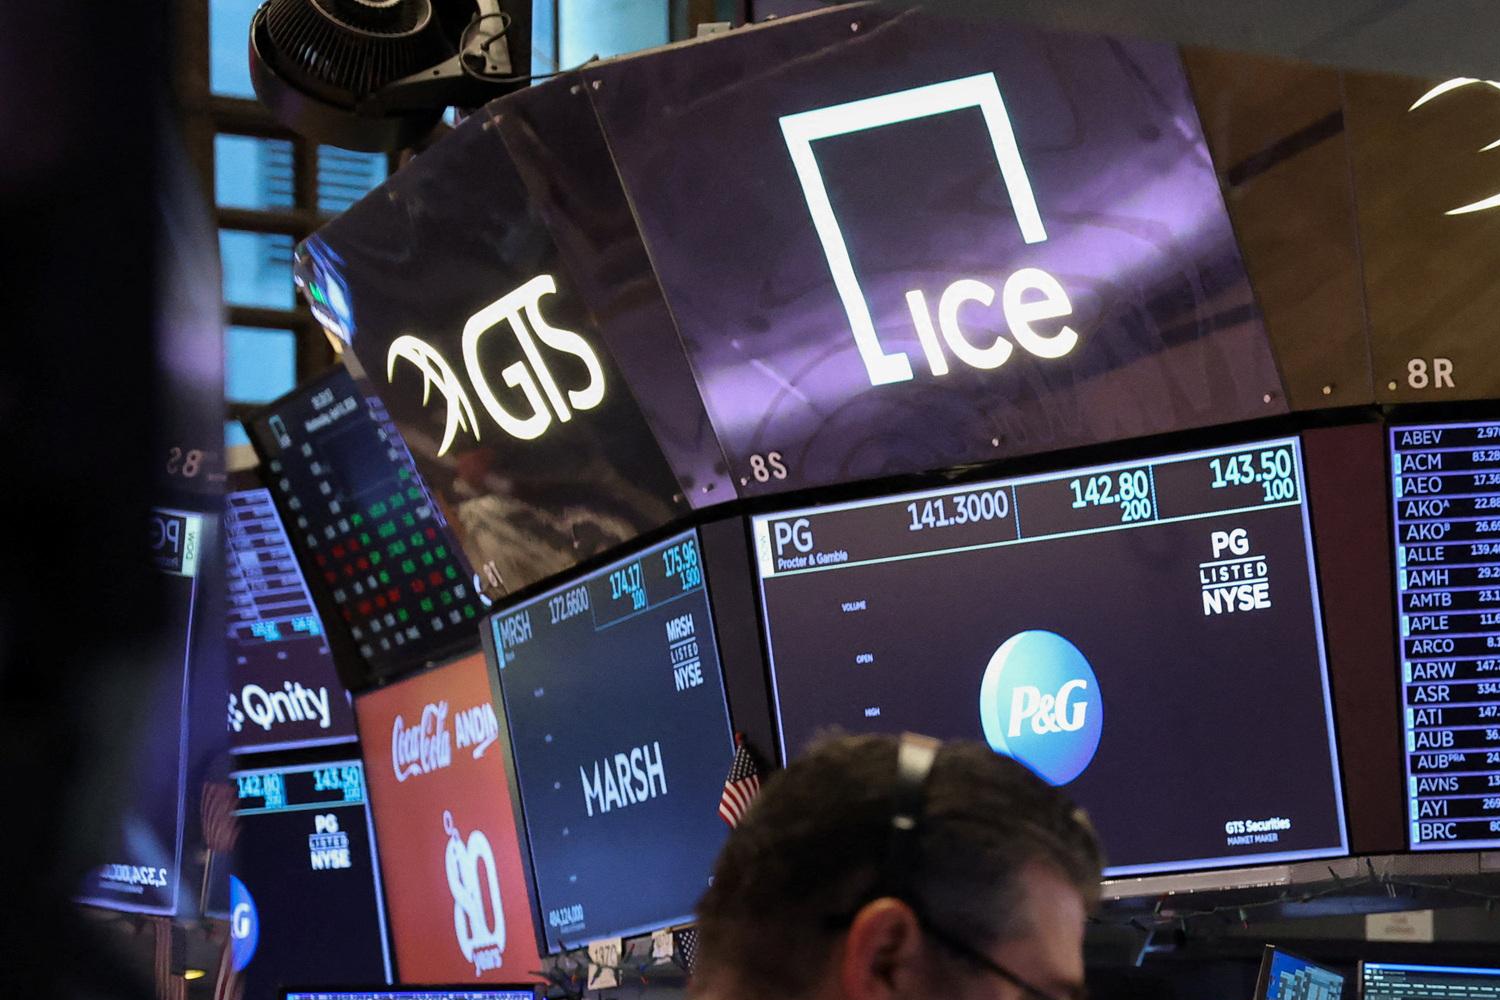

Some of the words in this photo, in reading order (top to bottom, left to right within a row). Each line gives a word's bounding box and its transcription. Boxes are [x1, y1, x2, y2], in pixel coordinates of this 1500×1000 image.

[462, 274, 606, 440] GTS
[1407, 358, 1455, 389] 8R
[1402, 430, 1442, 444] ABEV
[750, 452, 787, 482] 8S
[1403, 453, 1441, 469] ACM
[1262, 479, 1294, 502] 100
[1405, 476, 1441, 492] AEO
[774, 519, 813, 556] PG
[907, 490, 1009, 531] 141.3000
[1070, 470, 1149, 508] 142.80
[1209, 449, 1291, 488] 143.50
[1120, 499, 1151, 521] 200
[1211, 528, 1249, 558] PG
[1408, 546, 1444, 560] ALLE
[778, 555, 807, 570] Procter
[816, 550, 848, 564] Gamble
[680, 566, 700, 591] 1,900
[1200, 562, 1267, 584] LISTED
[1409, 569, 1448, 584] AMH
[500, 611, 532, 648] MRSH
[549, 586, 589, 624] 172.6600
[610, 564, 641, 599] 174.17
[663, 541, 697, 577] 175.96
[631, 589, 645, 610] 100
[1202, 583, 1271, 615] NYSE
[841, 600, 866, 612] VOLUME
[666, 614, 694, 641] MRSH
[1412, 615, 1448, 629] APLE
[671, 642, 698, 664] LISTED
[856, 653, 873, 664] OPEN
[674, 662, 703, 691] NYSE
[1414, 661, 1456, 677] ARW
[242, 682, 330, 730] Qnity
[1008, 679, 1087, 737] P&G
[1416, 707, 1441, 723] ATI
[314, 766, 359, 791] 143.50
[580, 741, 667, 817] MARSH
[1420, 777, 1458, 791] AVNS
[1421, 800, 1447, 815] AYI
[315, 814, 338, 833] PG
[1225, 821, 1245, 834] GTS
[1245, 817, 1291, 832] Securities
[309, 835, 348, 849] LISTED
[1227, 835, 1254, 846] MARKET
[1254, 833, 1278, 843] MAKER
[311, 850, 351, 870] NYSE
